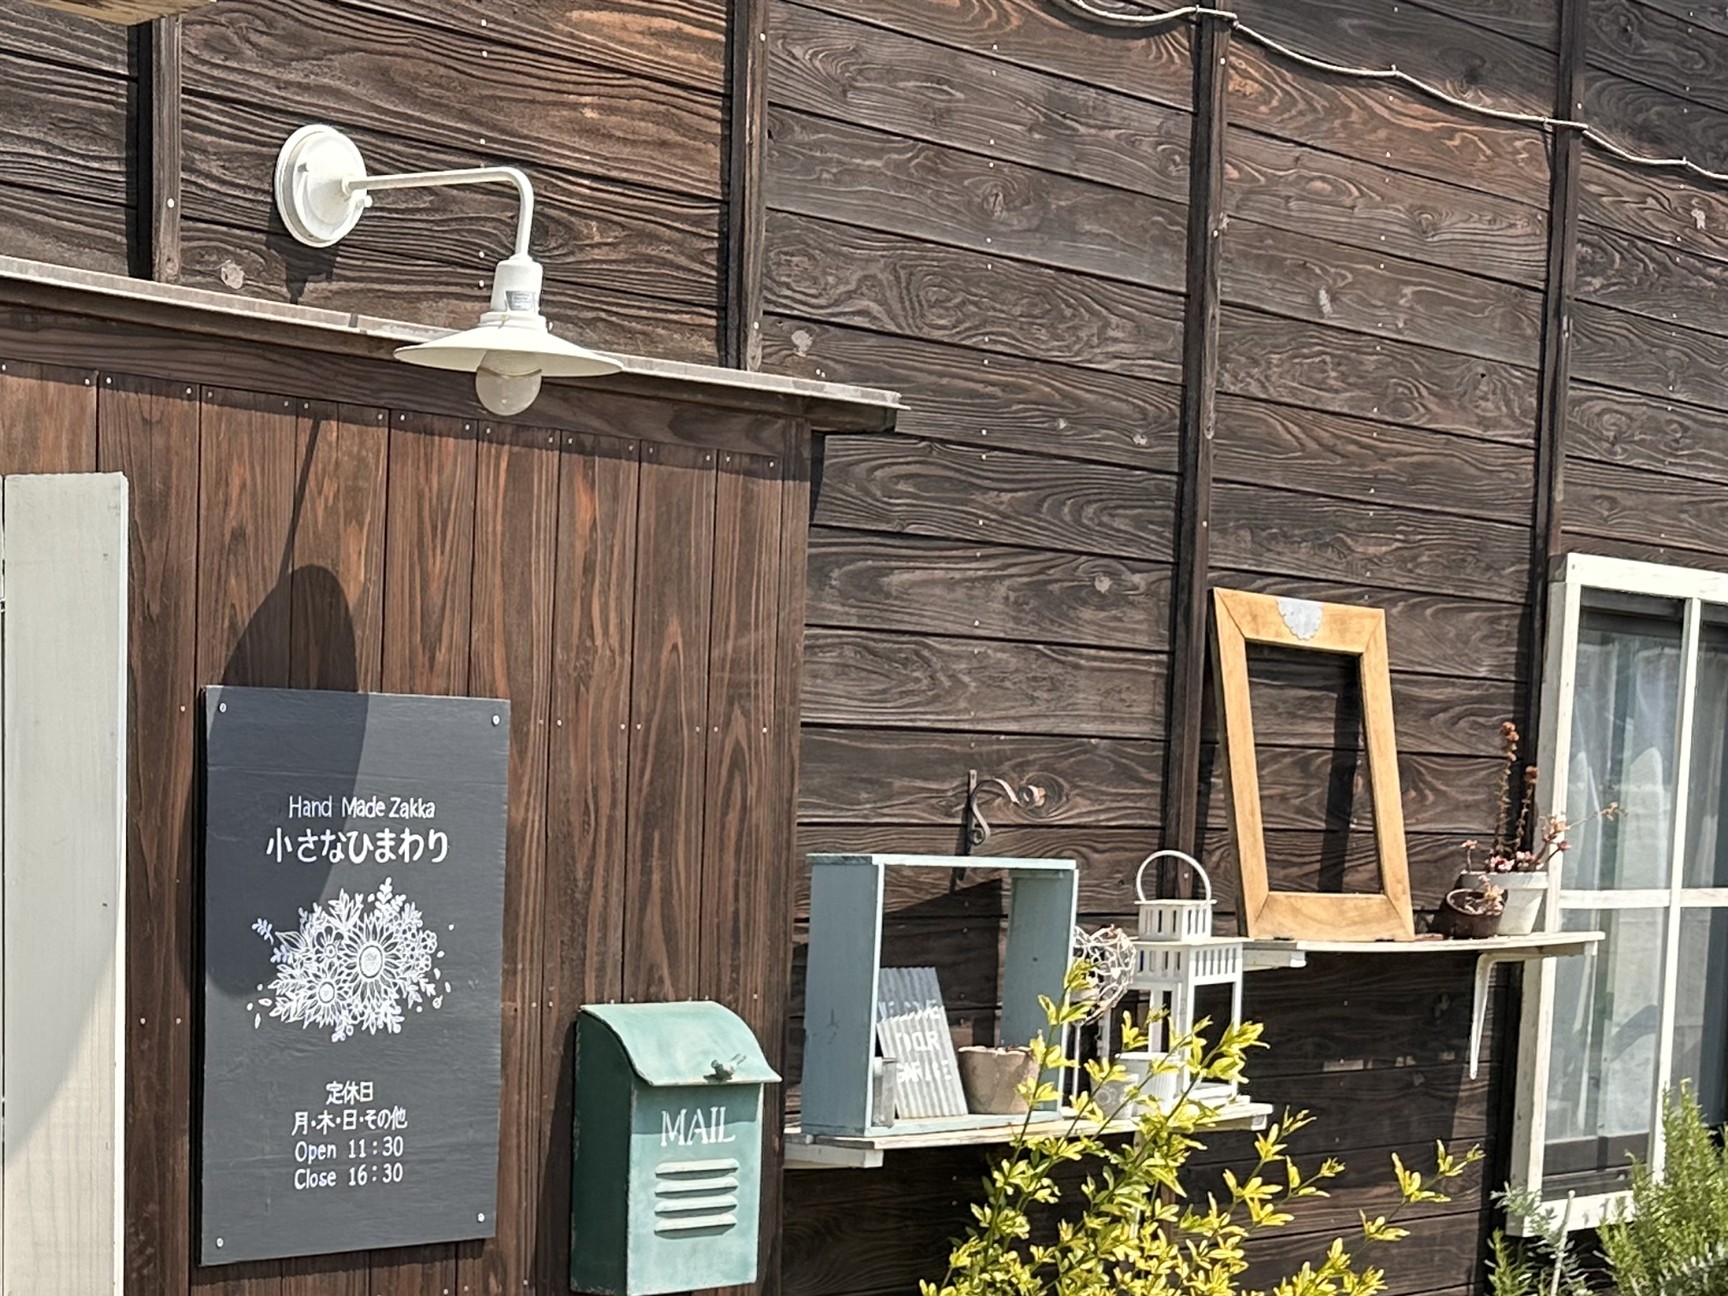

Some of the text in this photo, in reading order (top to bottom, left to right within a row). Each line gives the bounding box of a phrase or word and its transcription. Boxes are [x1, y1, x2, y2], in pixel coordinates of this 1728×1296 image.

[289, 795, 436, 820] Hand Made Zakka
[266, 827, 449, 865] 小さなひまわり
[326, 1080, 373, 1105] 定休日
[660, 1106, 736, 1147] MAIL
[295, 1141, 337, 1165] Open
[294, 1167, 337, 1190] Close
